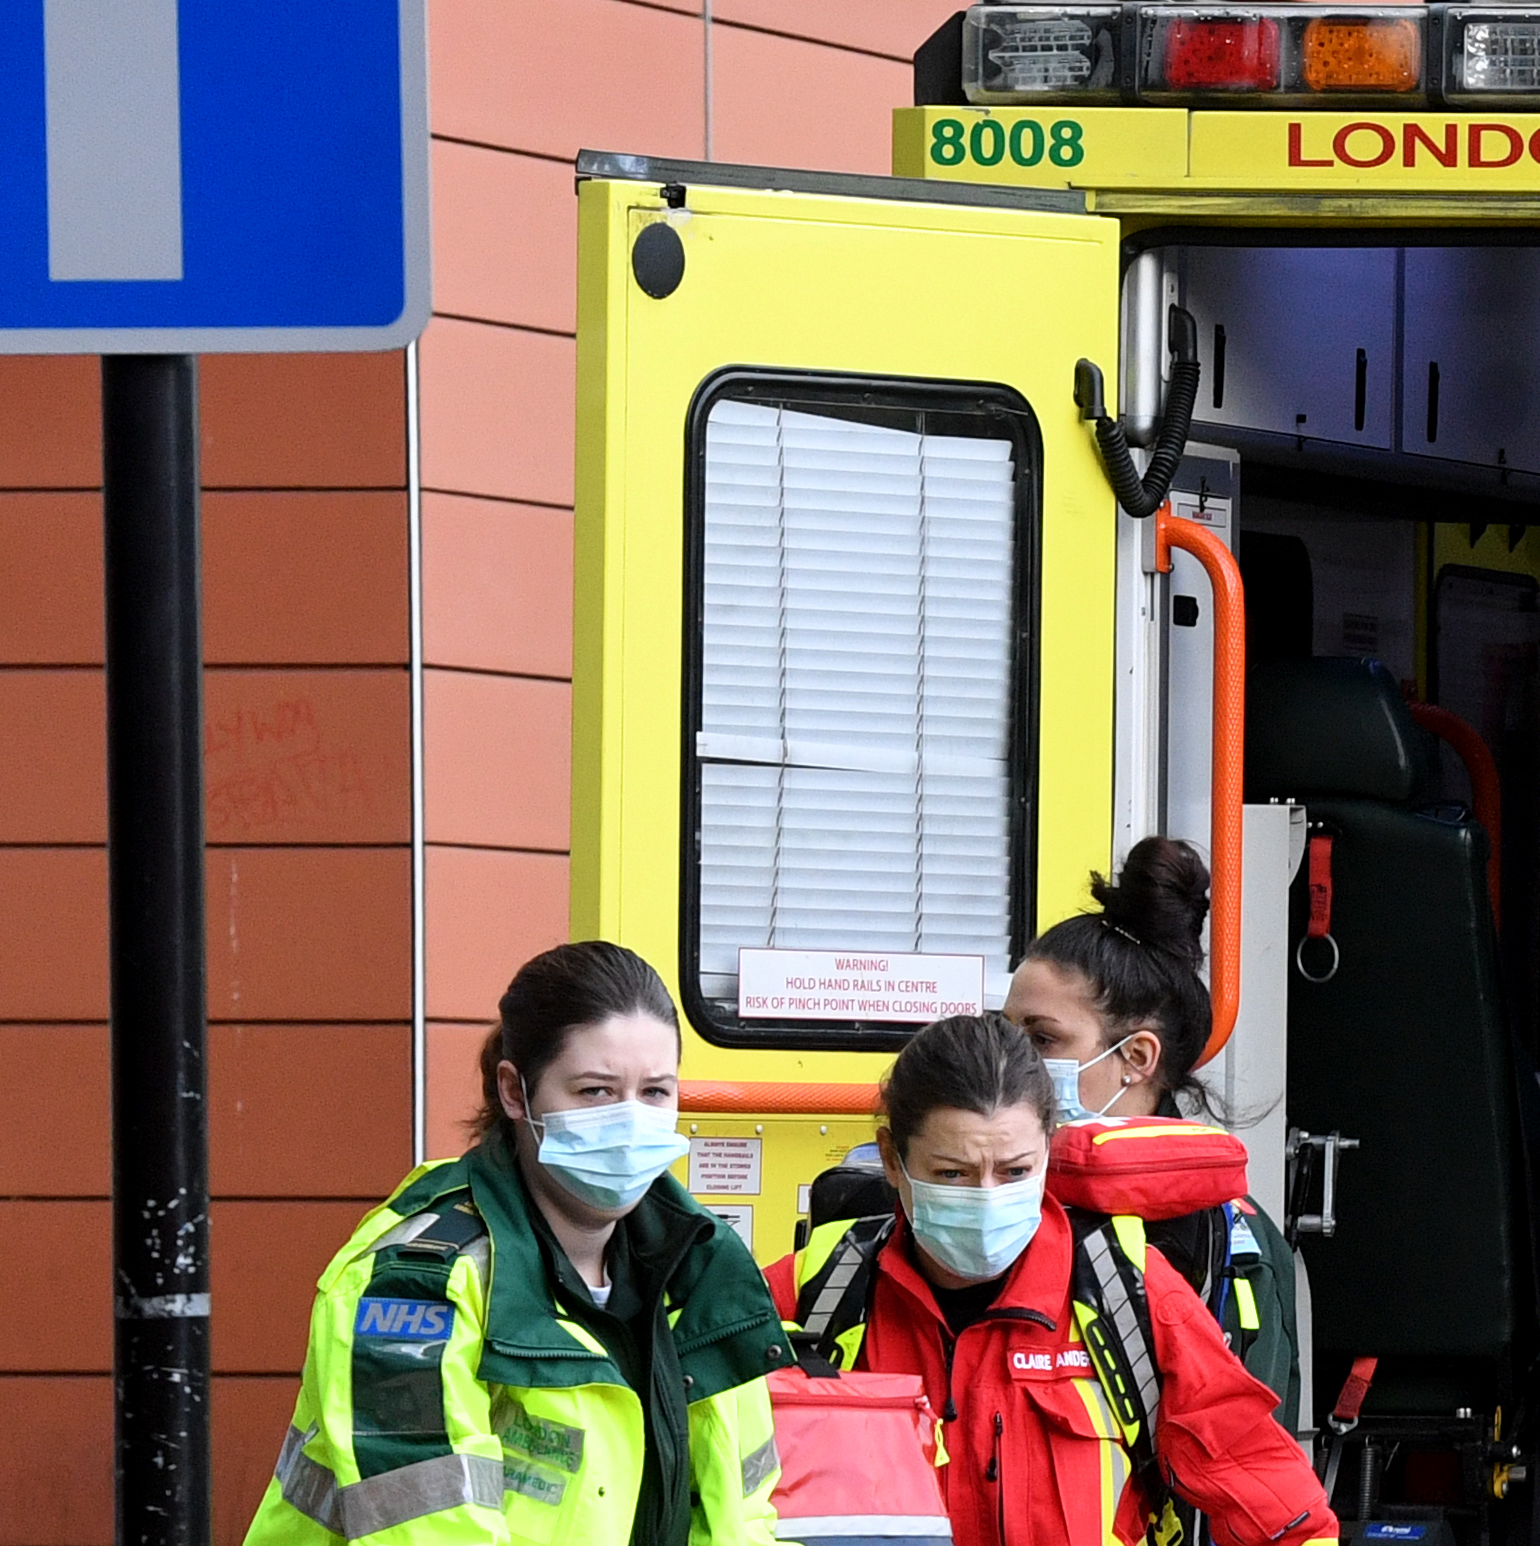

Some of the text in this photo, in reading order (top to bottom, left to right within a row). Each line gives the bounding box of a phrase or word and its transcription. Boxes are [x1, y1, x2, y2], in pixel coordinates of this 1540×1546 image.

[930, 119, 1084, 167] 8008
[835, 958, 889, 972] WARNING!
[785, 977, 938, 993] HOLD HAND RAILS IN CENTRE
[746, 996, 977, 1015] RISK OF PINCH POINT WHEN CLOSING DOORS
[360, 1302, 450, 1335] NHS
[1013, 1352, 1053, 1370] CLAIRE
